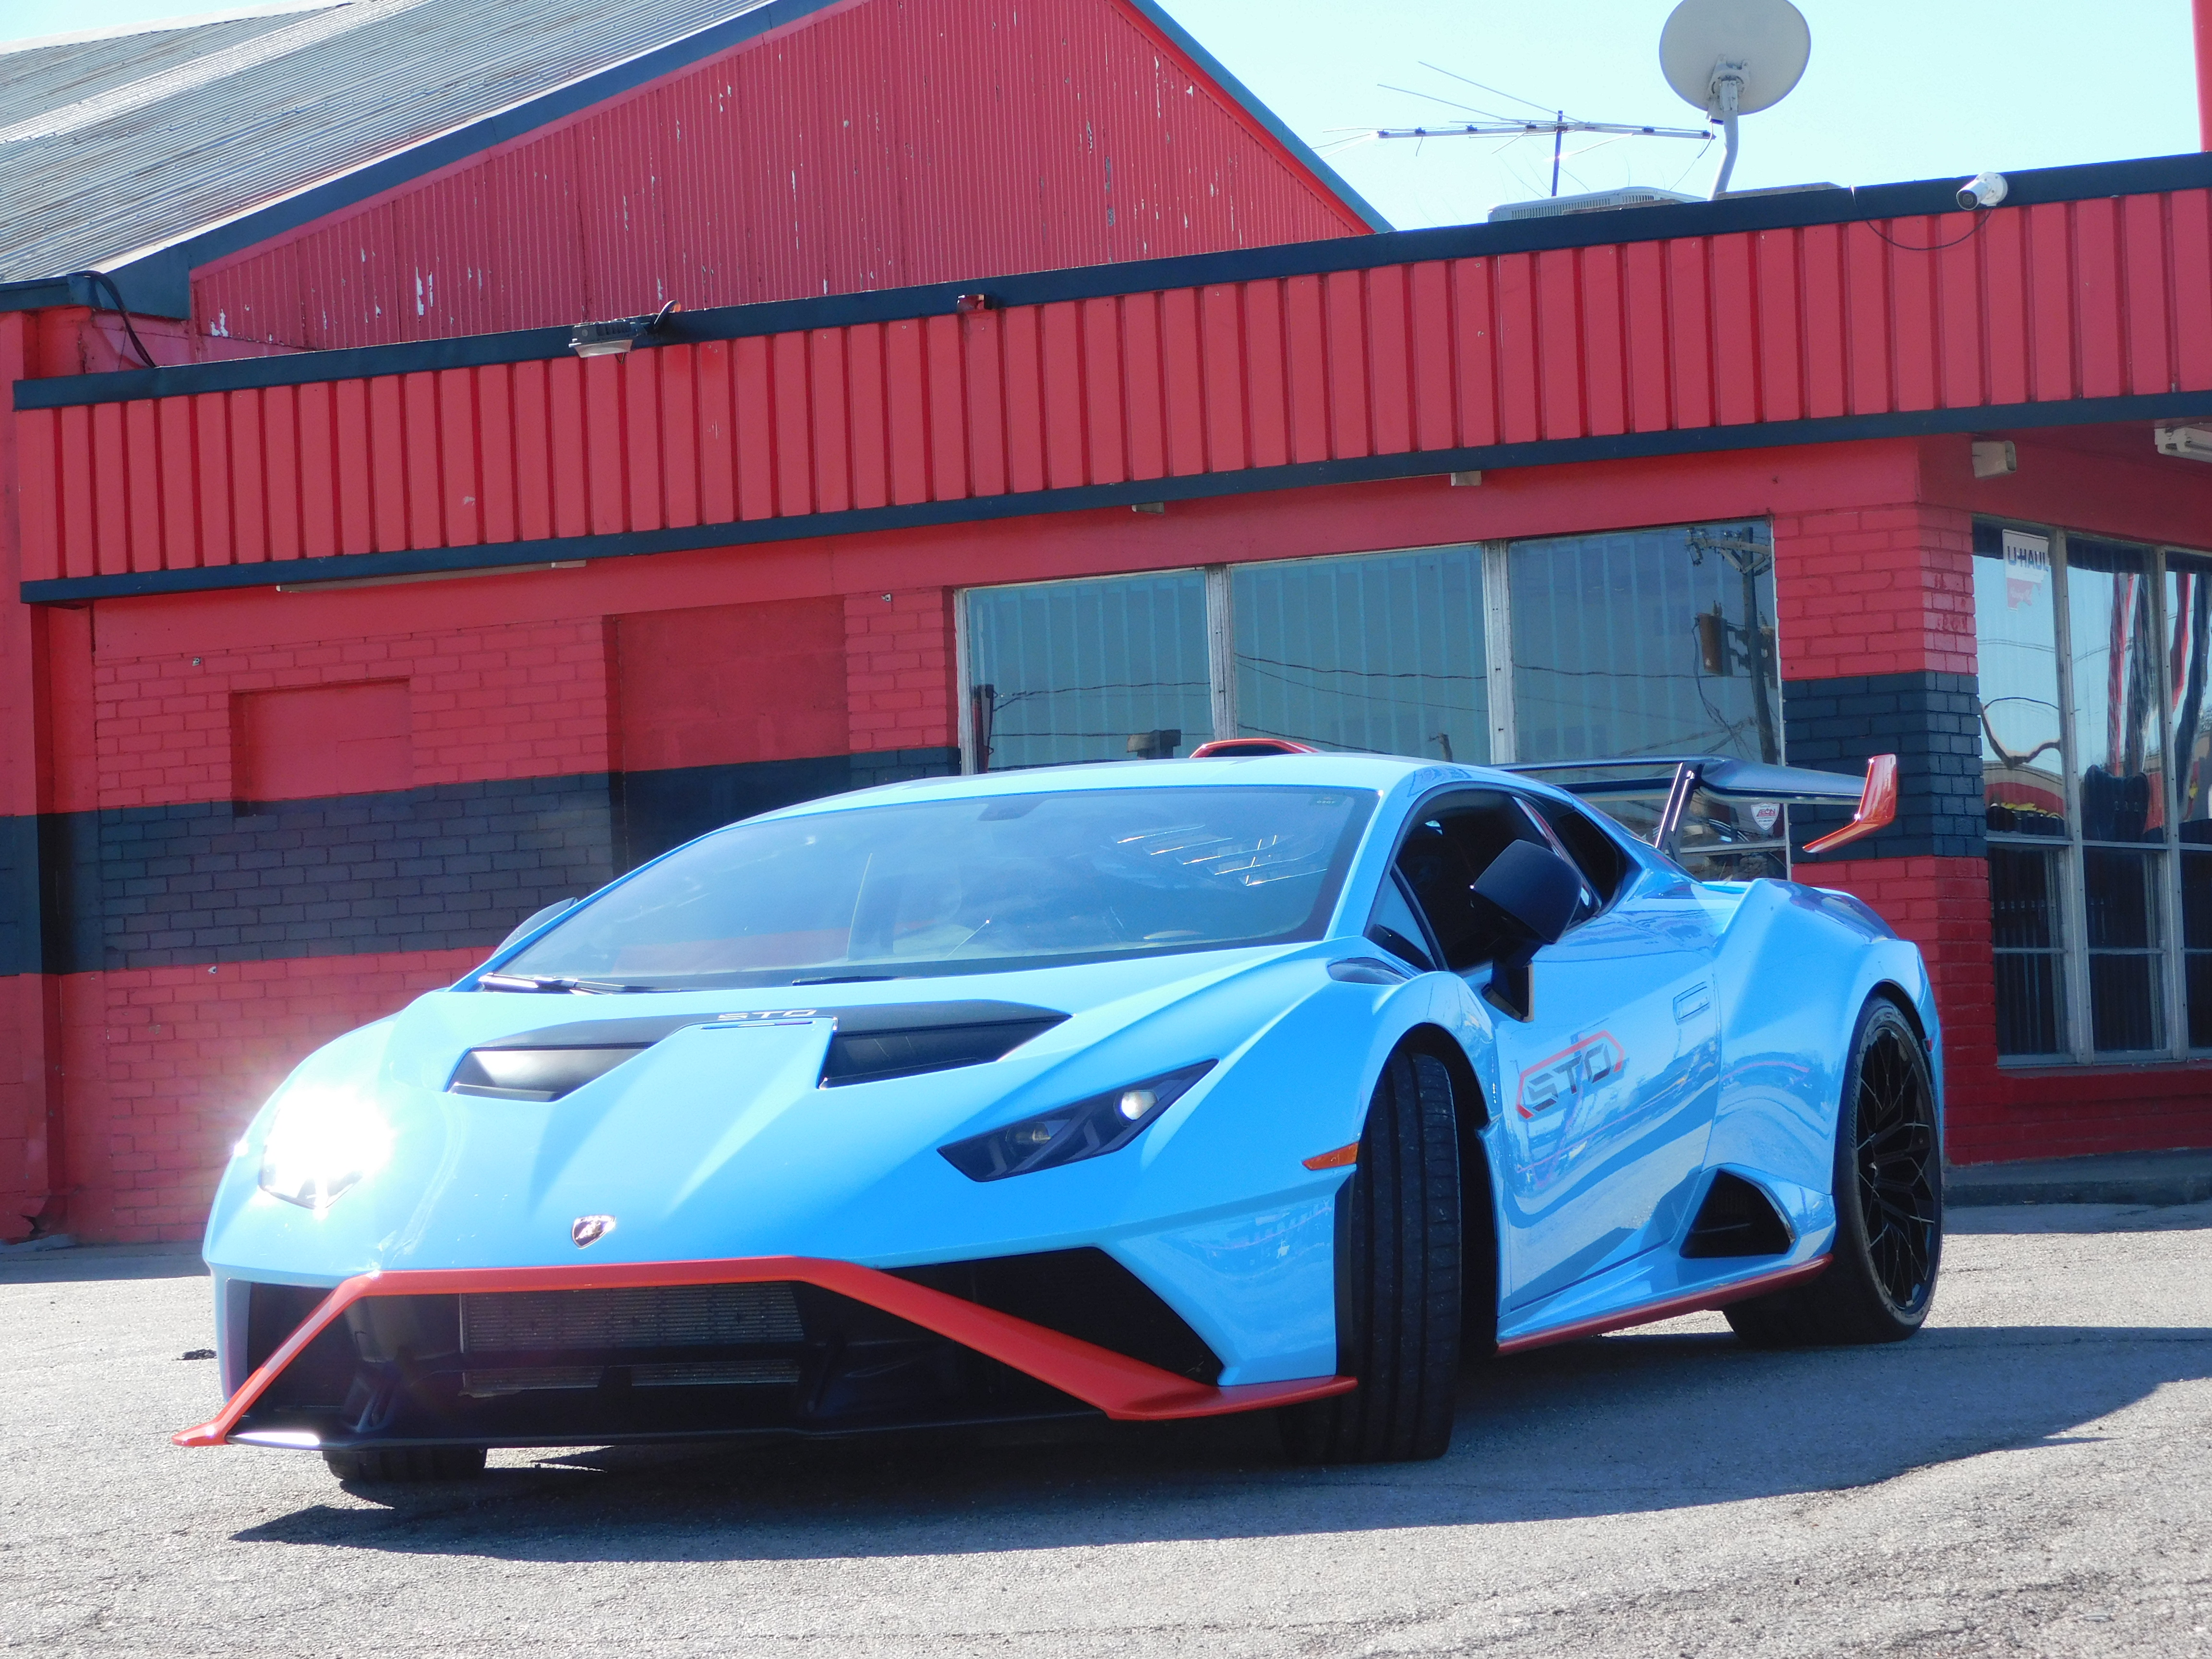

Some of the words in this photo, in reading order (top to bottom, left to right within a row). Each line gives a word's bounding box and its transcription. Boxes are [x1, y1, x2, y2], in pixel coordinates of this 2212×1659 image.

[2007, 545, 2049, 572] U-HAUL
[718, 1009, 817, 1021] STO
[1527, 1043, 1611, 1112] STO
